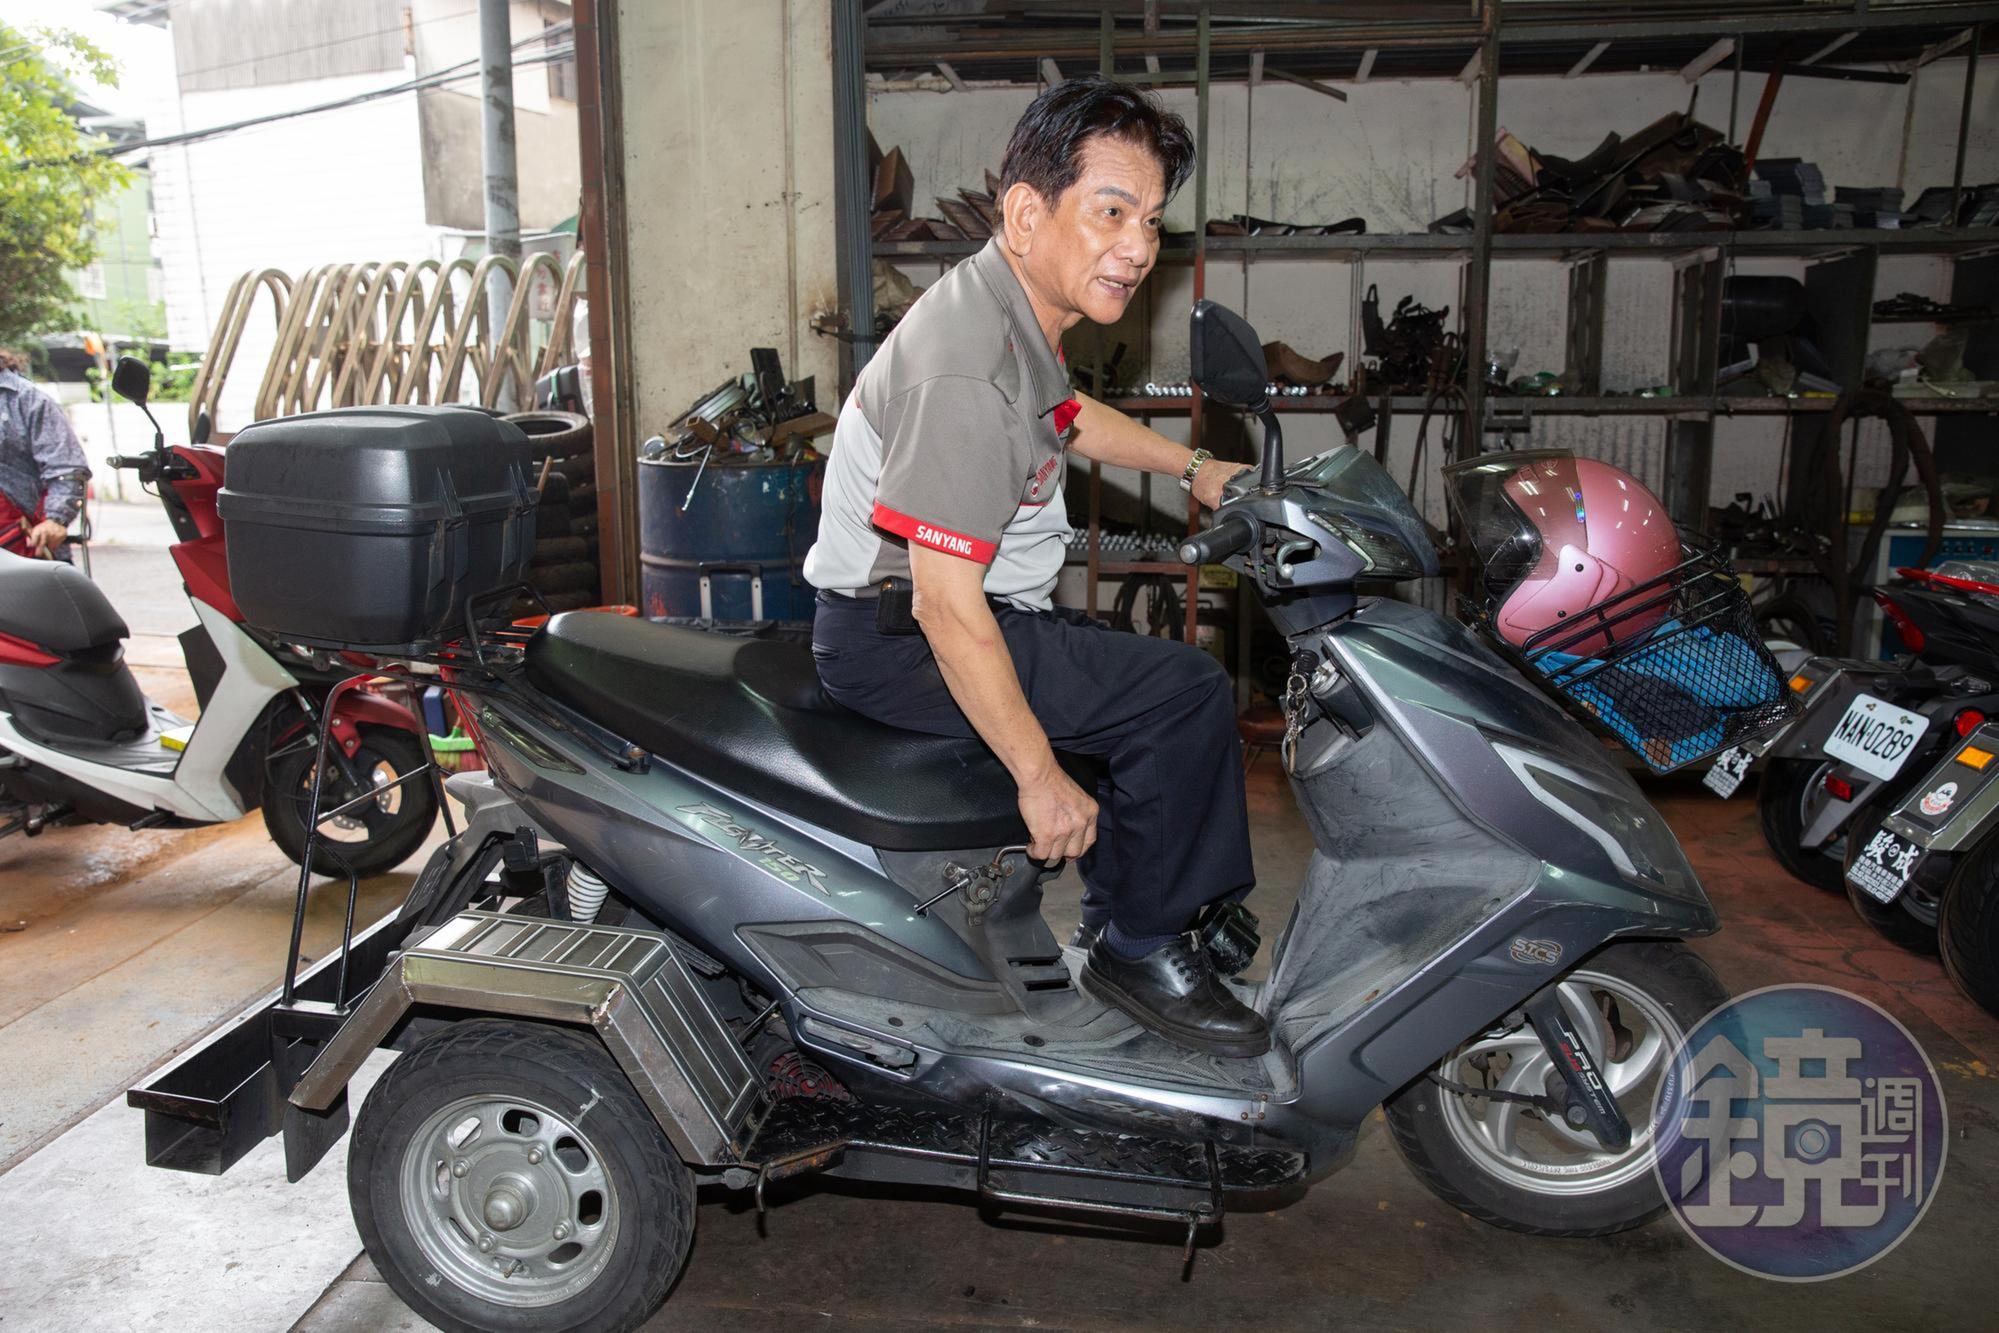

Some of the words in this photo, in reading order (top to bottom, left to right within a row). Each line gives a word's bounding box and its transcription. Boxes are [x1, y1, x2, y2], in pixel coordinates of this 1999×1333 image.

[915, 525, 972, 555] SANYANG
[675, 801, 831, 897] FIGHTER
[758, 857, 801, 881] 150
[1564, 1031, 1602, 1090] PRO
